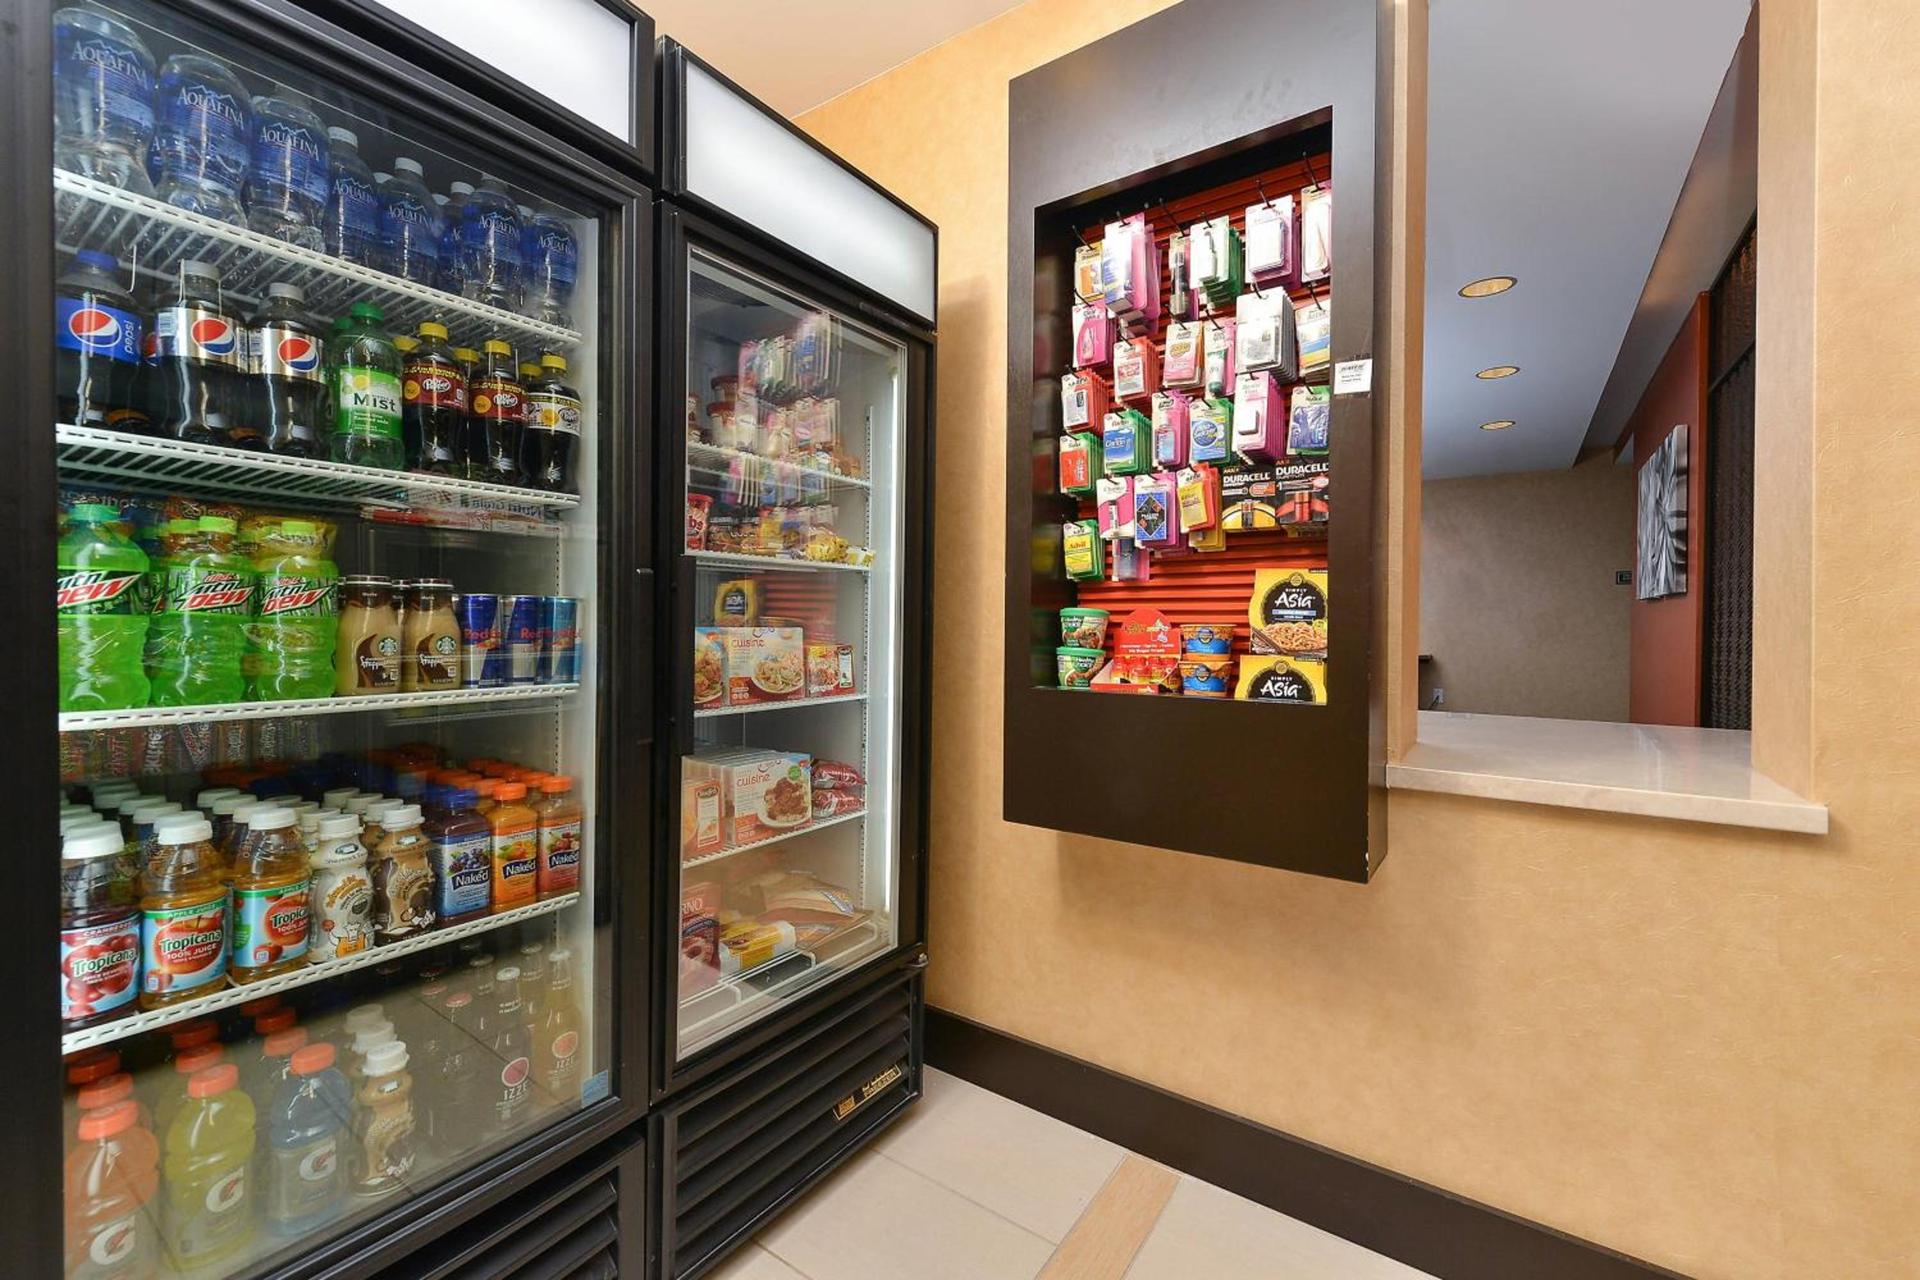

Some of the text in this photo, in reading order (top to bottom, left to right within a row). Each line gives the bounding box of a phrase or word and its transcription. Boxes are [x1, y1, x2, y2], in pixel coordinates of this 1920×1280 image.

[71, 40, 149, 90] AQUAFINA
[176, 86, 244, 130] AQUAFINA
[260, 126, 319, 162] AQUAFINA
[124, 319, 136, 354] pepsi
[353, 393, 396, 412] Mist
[1223, 472, 1270, 484] DURACELL
[1275, 462, 1329, 476] DURACELL
[1275, 592, 1313, 608] Asia
[1260, 679, 1299, 697] Asia
[737, 773, 769, 787] cuisine
[454, 870, 489, 887] Naked
[271, 907, 309, 928] Tropica
[160, 929, 223, 954] Tropicana
[164, 943, 218, 960] 100% JUICE
[72, 948, 136, 977] Tropicana
[503, 1082, 528, 1100] IZZE
